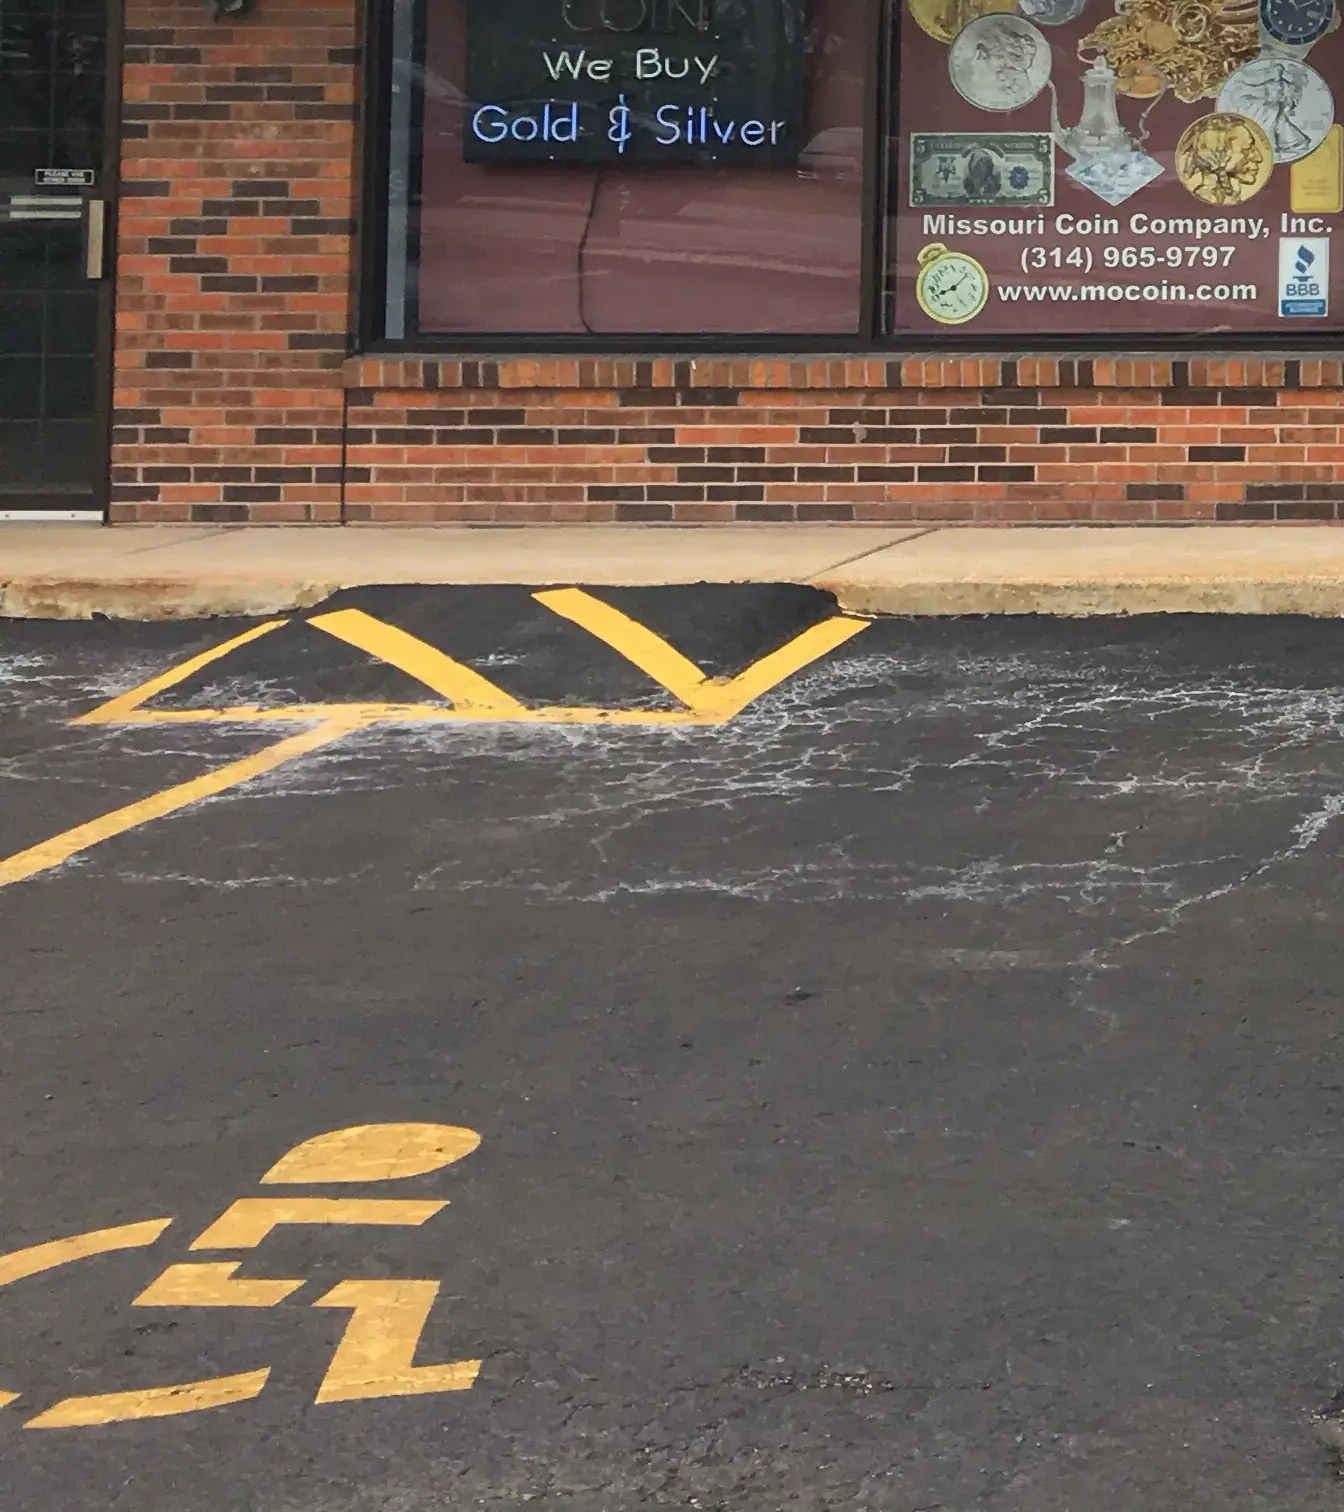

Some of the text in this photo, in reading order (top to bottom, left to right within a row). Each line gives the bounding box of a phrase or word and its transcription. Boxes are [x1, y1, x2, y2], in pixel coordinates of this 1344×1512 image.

[542, 48, 719, 85] We Buy
[472, 94, 784, 154] Gold & Silver
[922, 213, 1333, 239] Missouri Coin Company, Inc.
[1020, 245, 1237, 274] (314) 965-9797
[997, 280, 1258, 302] www.mocoin.com
[1285, 283, 1320, 297] BBB
